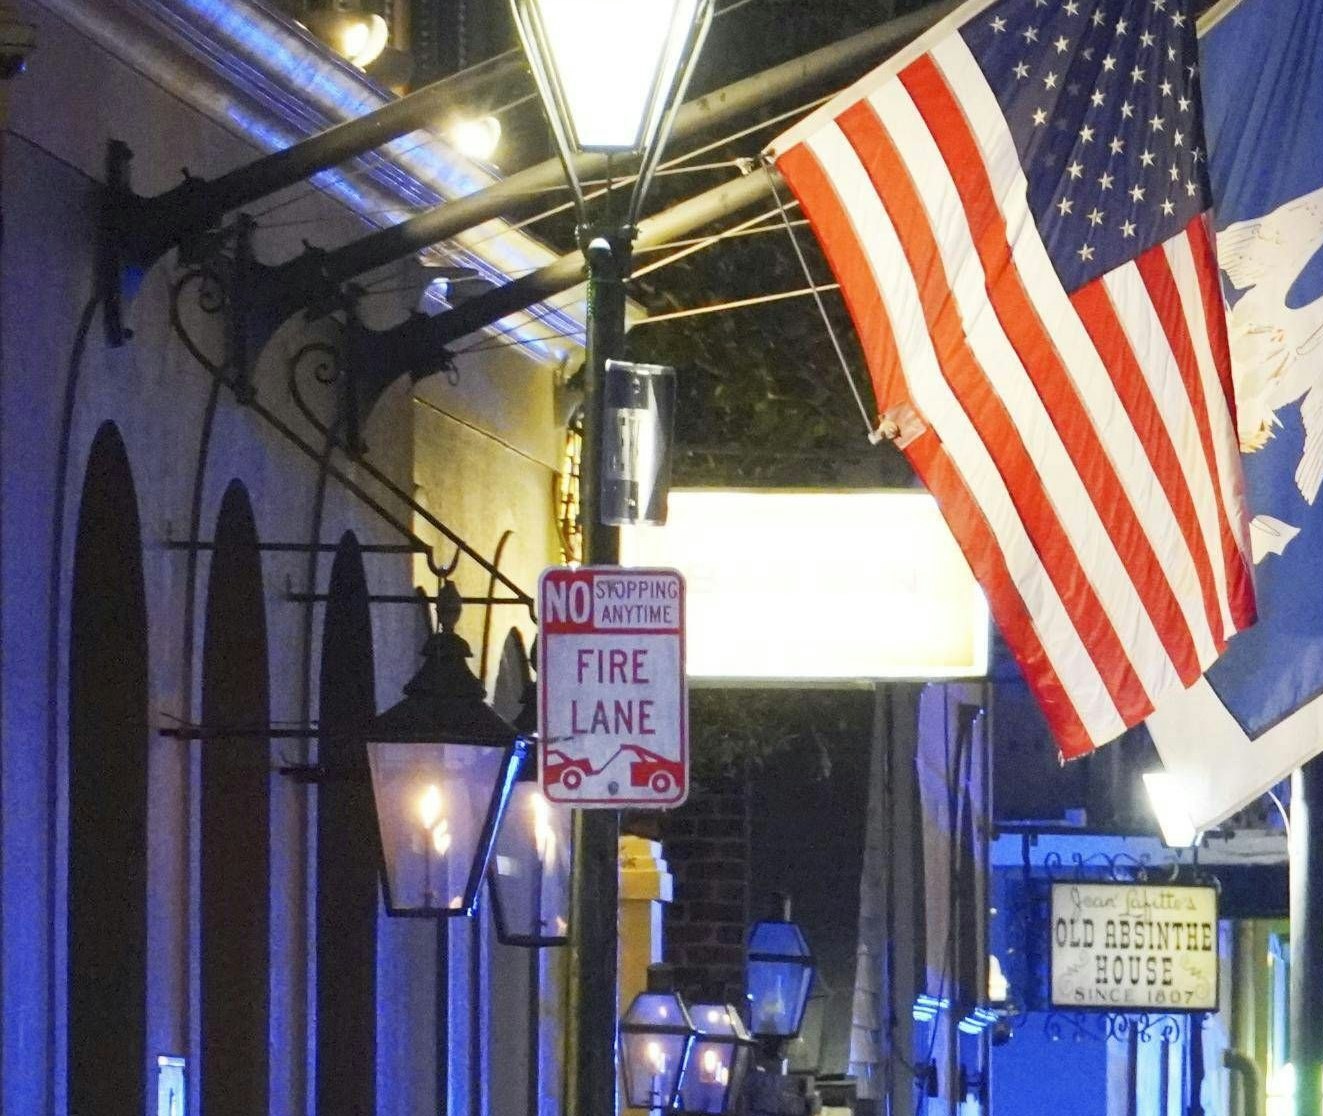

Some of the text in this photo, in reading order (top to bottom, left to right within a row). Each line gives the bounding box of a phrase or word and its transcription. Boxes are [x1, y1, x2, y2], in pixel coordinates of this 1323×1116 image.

[546, 580, 679, 624] NO STOPPING
[602, 604, 673, 624] ANYTIME
[577, 649, 650, 685] FIRE
[571, 699, 656, 735] LANE
[1056, 917, 1212, 951] OLD ABSINTHE
[1096, 955, 1174, 986] HOUSE
[1075, 988, 1133, 1002] SINCE
